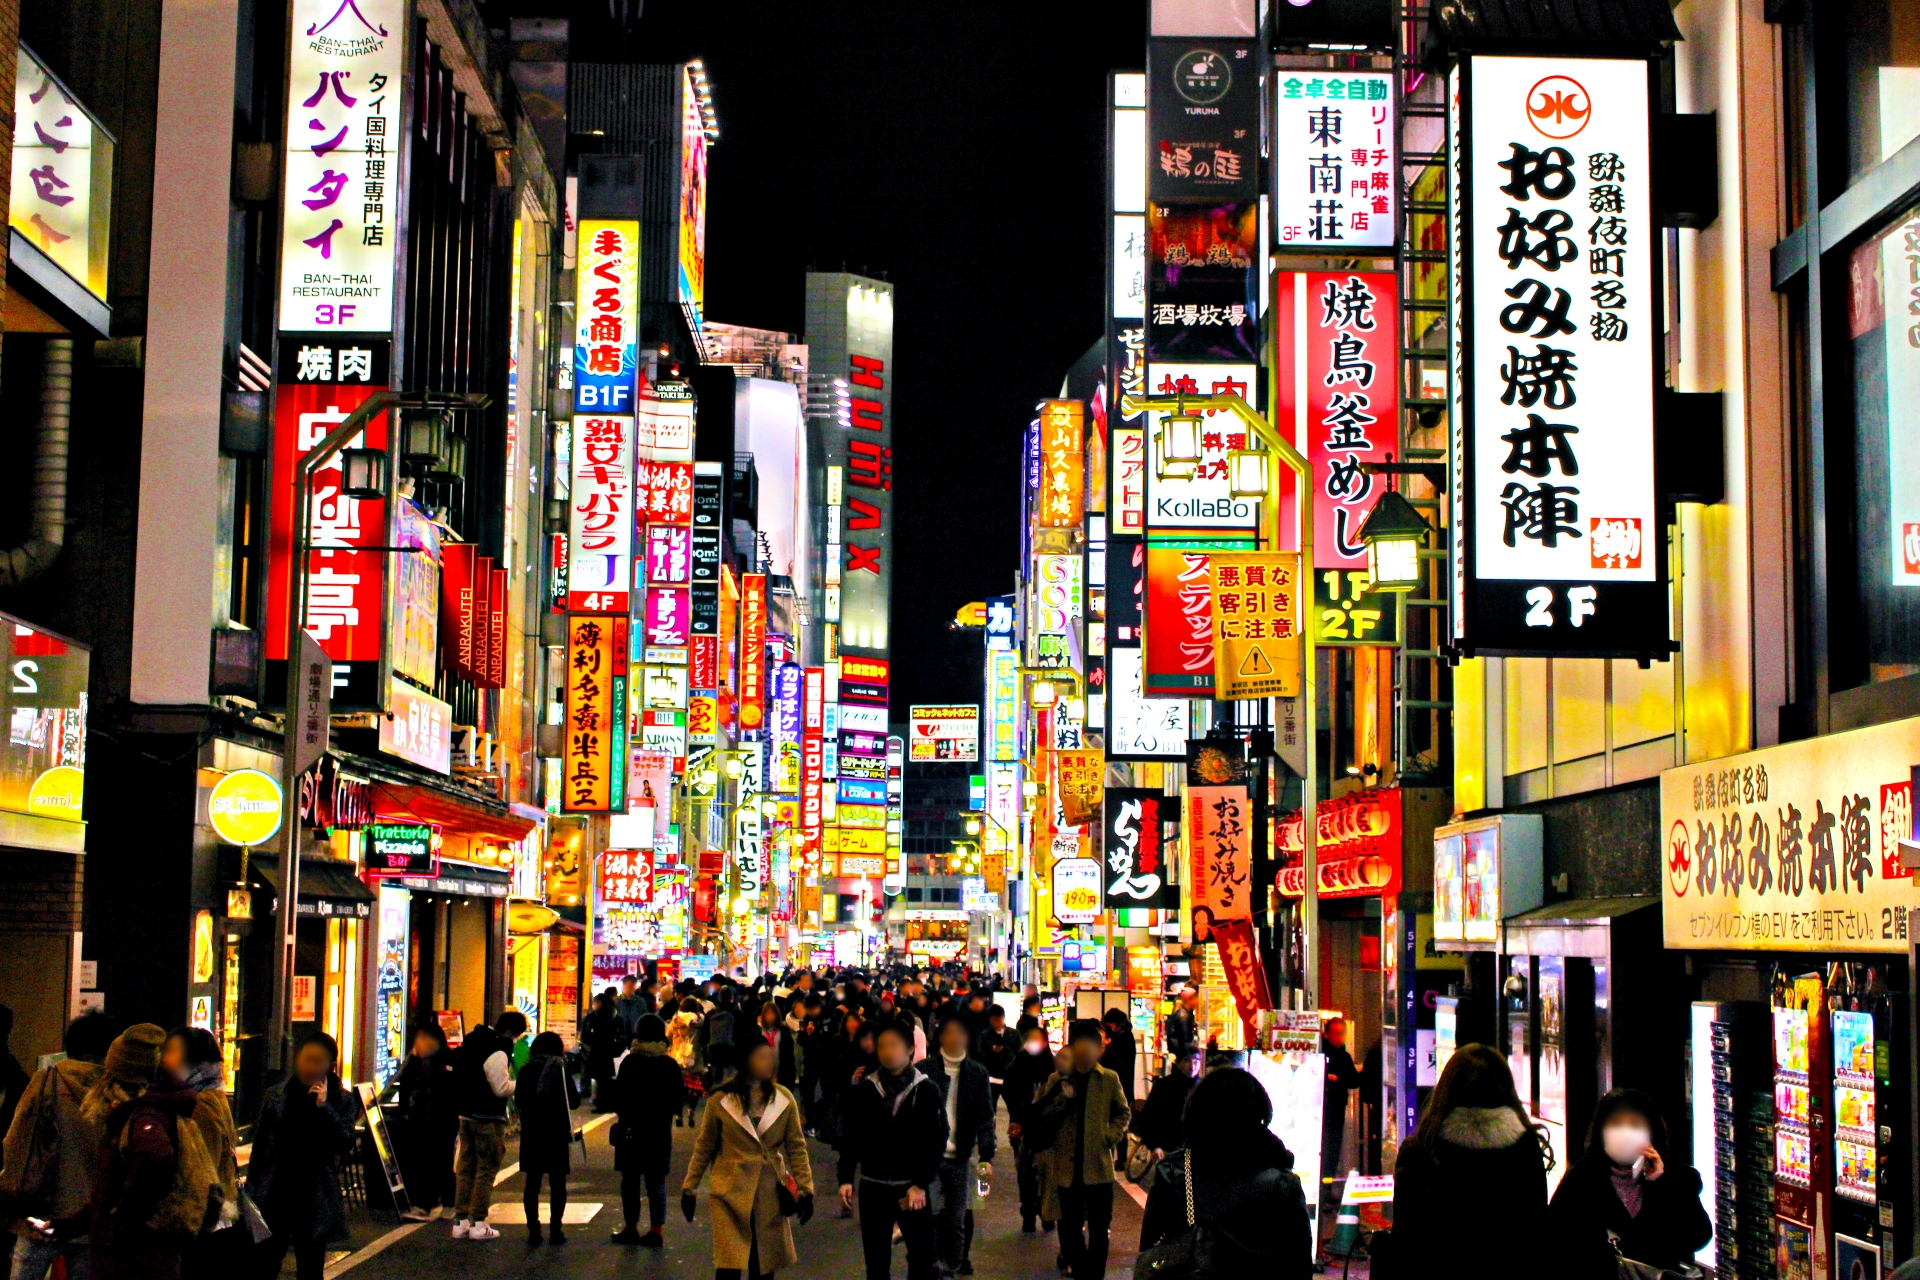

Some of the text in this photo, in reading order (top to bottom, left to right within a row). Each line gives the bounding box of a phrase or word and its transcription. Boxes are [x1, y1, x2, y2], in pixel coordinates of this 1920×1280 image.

[309, 40, 385, 58] RESTAURANT
[1235, 49, 1248, 59] 3F
[1283, 77, 1388, 101] 全卓全自動
[1185, 107, 1220, 116] YURUHA
[302, 70, 358, 260] バンタイ
[362, 72, 388, 247] タイ国料理専門店
[1307, 105, 1345, 242] 東南荘
[1370, 105, 1389, 215] リーチ麻雀
[1350, 148, 1369, 232] 専門店
[1156, 208, 1170, 217] 2F
[1282, 226, 1302, 242] 3F
[1587, 151, 1628, 343] 歌舞伎町名物
[293, 287, 381, 298] RESTAURANT
[303, 274, 373, 284] BAN-THAI
[315, 304, 356, 325] 3F
[589, 230, 623, 373] まぐろ商店
[1152, 303, 1248, 327] 酒場牧場
[1497, 141, 1583, 550] お好み焼本陣
[297, 346, 372, 382] 焼肉
[580, 385, 629, 406] B1F
[1320, 276, 1377, 560] 焼鳥釜めし
[576, 418, 630, 551] 熟女キャバクラ
[1121, 434, 1144, 529] クアトロ
[1157, 497, 1249, 518] KollaBo
[1218, 565, 1290, 588] 悪質な
[583, 593, 615, 611] 4F
[1218, 592, 1291, 615] 客引き
[1525, 585, 1597, 627] 2F
[459, 587, 473, 667] ANRAKUTEI
[475, 599, 489, 677] ANRAKUTEI
[1220, 617, 1293, 640] に注意
[1320, 608, 1382, 640] 2F
[490, 611, 503, 685] ANRAKUTEI
[780, 667, 800, 730] カラオケ
[1693, 763, 1769, 813] 歌舞伎町名物
[374, 825, 430, 840] Trattoria
[374, 840, 426, 855] Pizzeria
[1694, 793, 1875, 899] お好み焼本陣
[387, 855, 411, 867] Bar
[1209, 796, 1247, 908] お好み焼き
[1065, 891, 1097, 906] 190円
[1881, 904, 1908, 941] 2階
